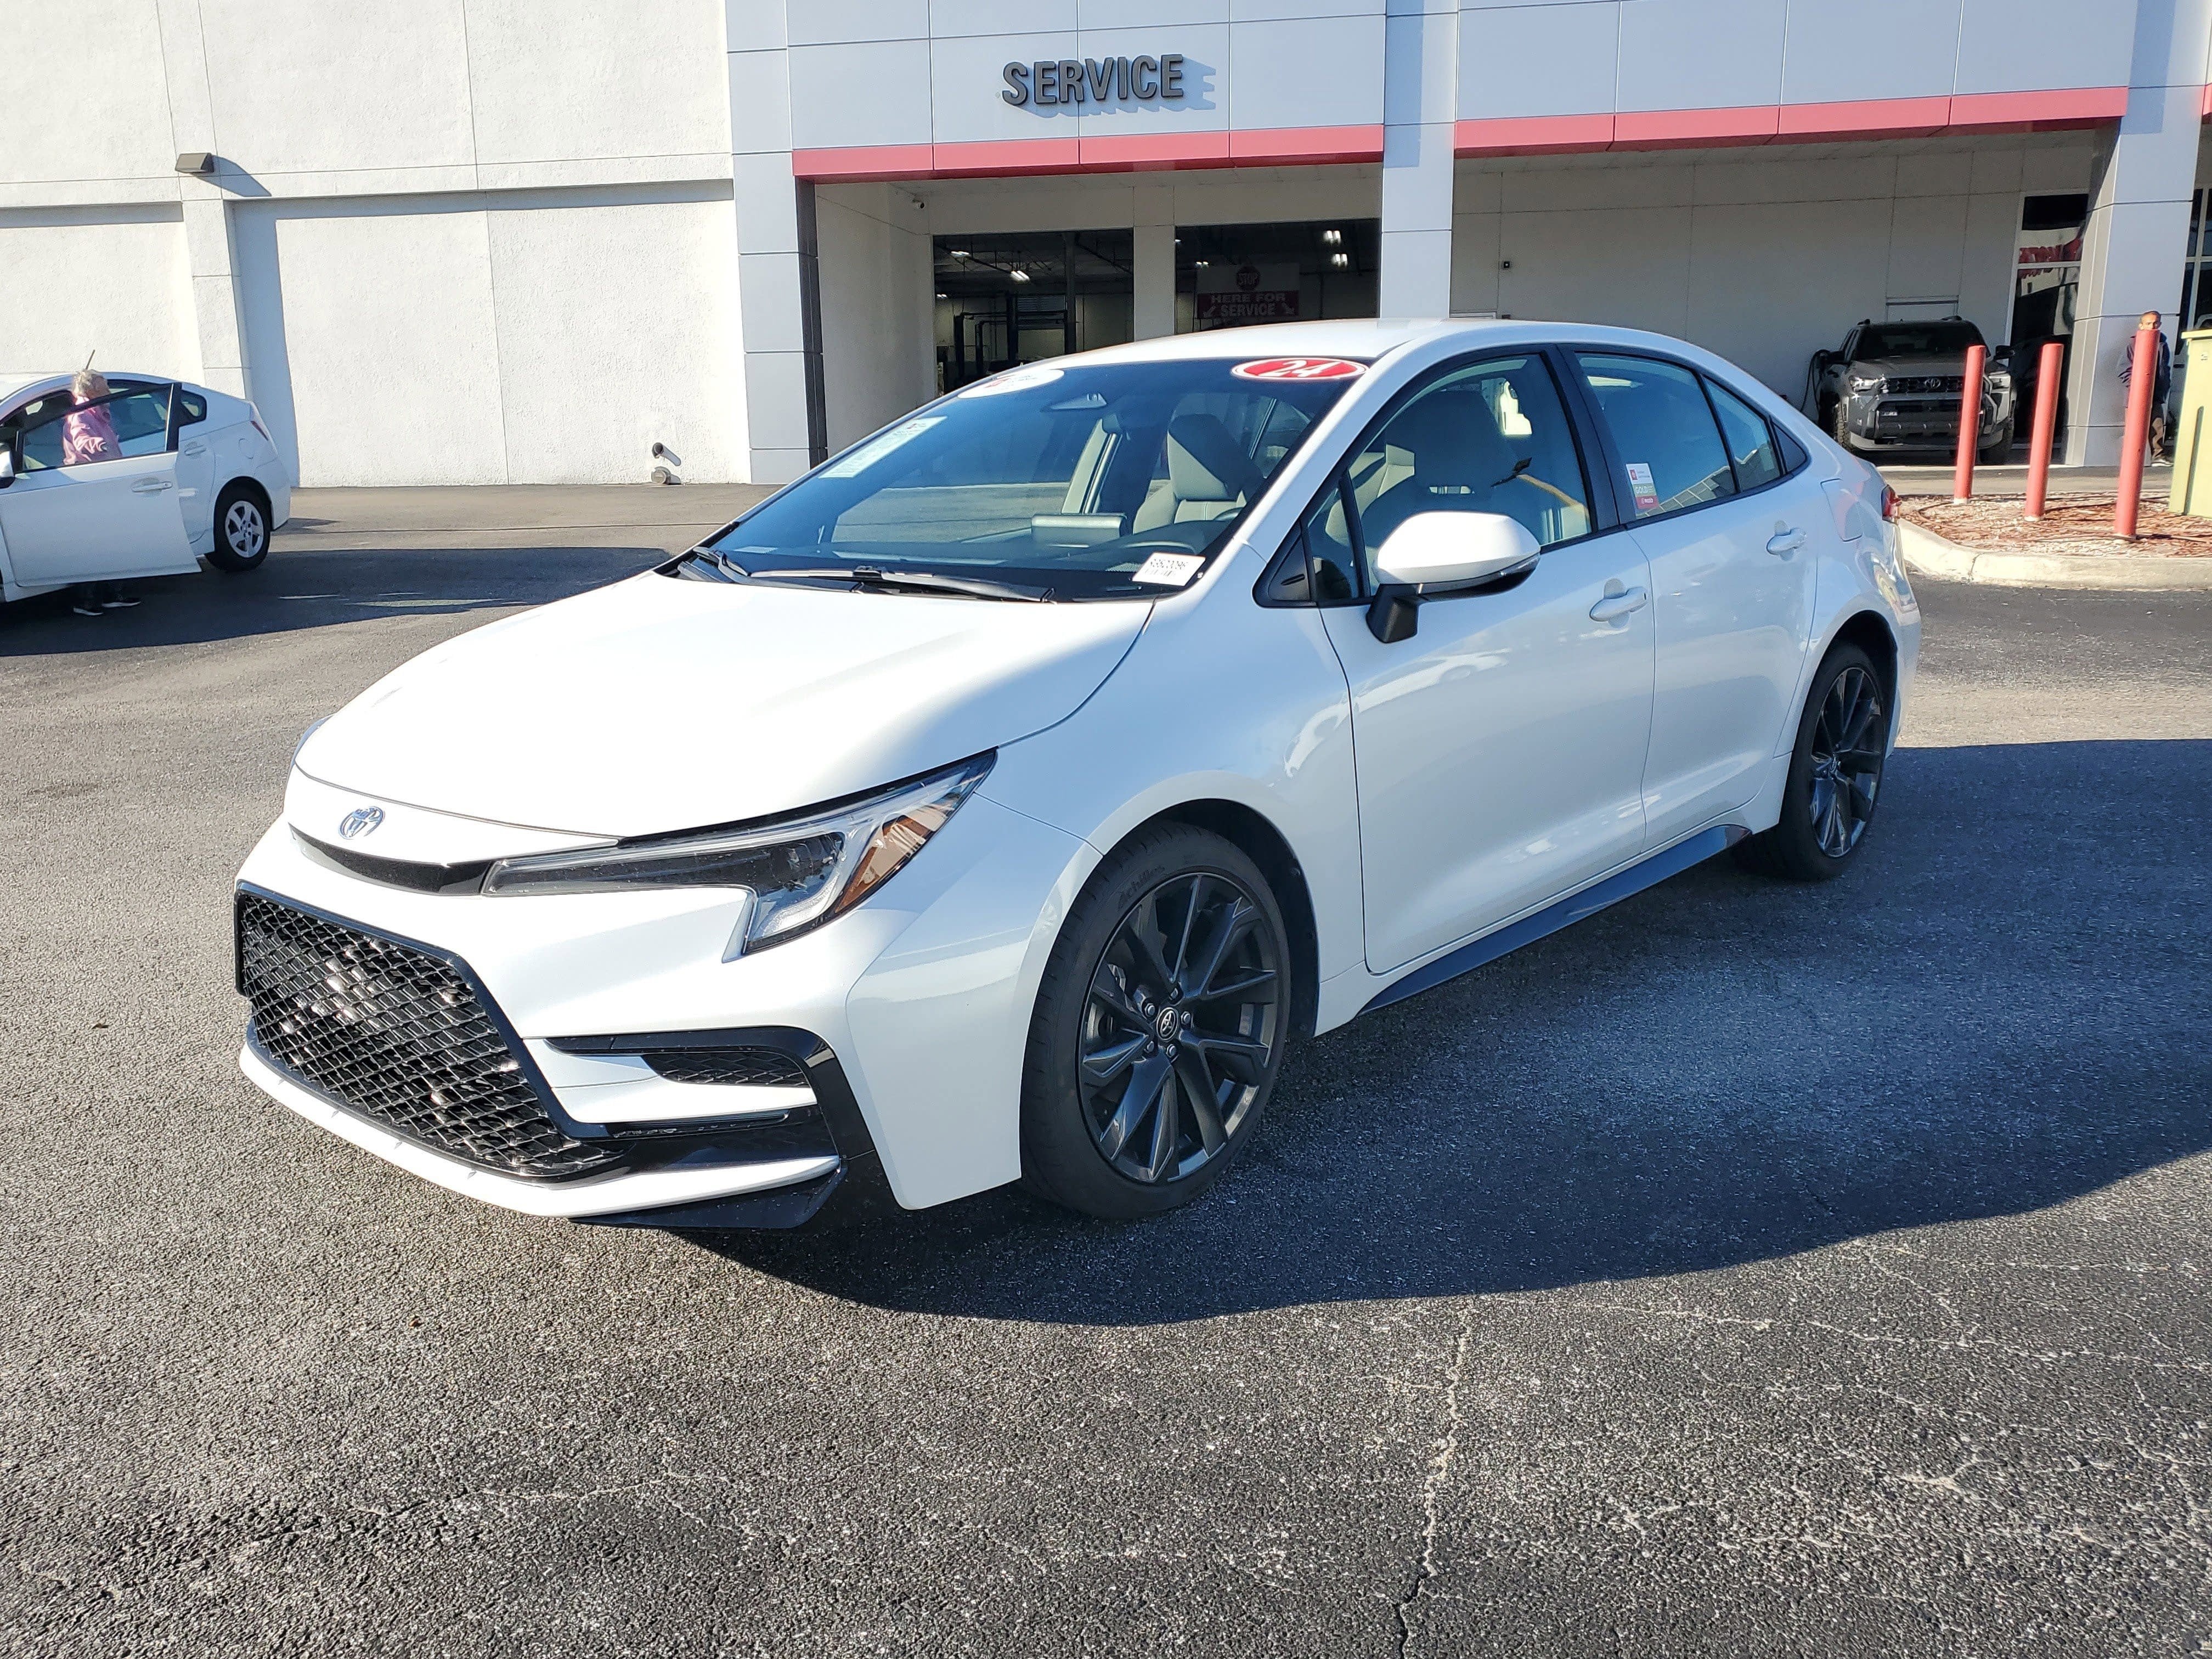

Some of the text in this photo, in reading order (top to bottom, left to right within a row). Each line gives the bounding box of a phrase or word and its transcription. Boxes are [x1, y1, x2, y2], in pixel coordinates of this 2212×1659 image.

[1002, 54, 1184, 106] SERVICE
[1211, 292, 1285, 303] HERE FOR
[1221, 303, 1276, 317] SERVICE
[1259, 360, 1342, 377] 24
